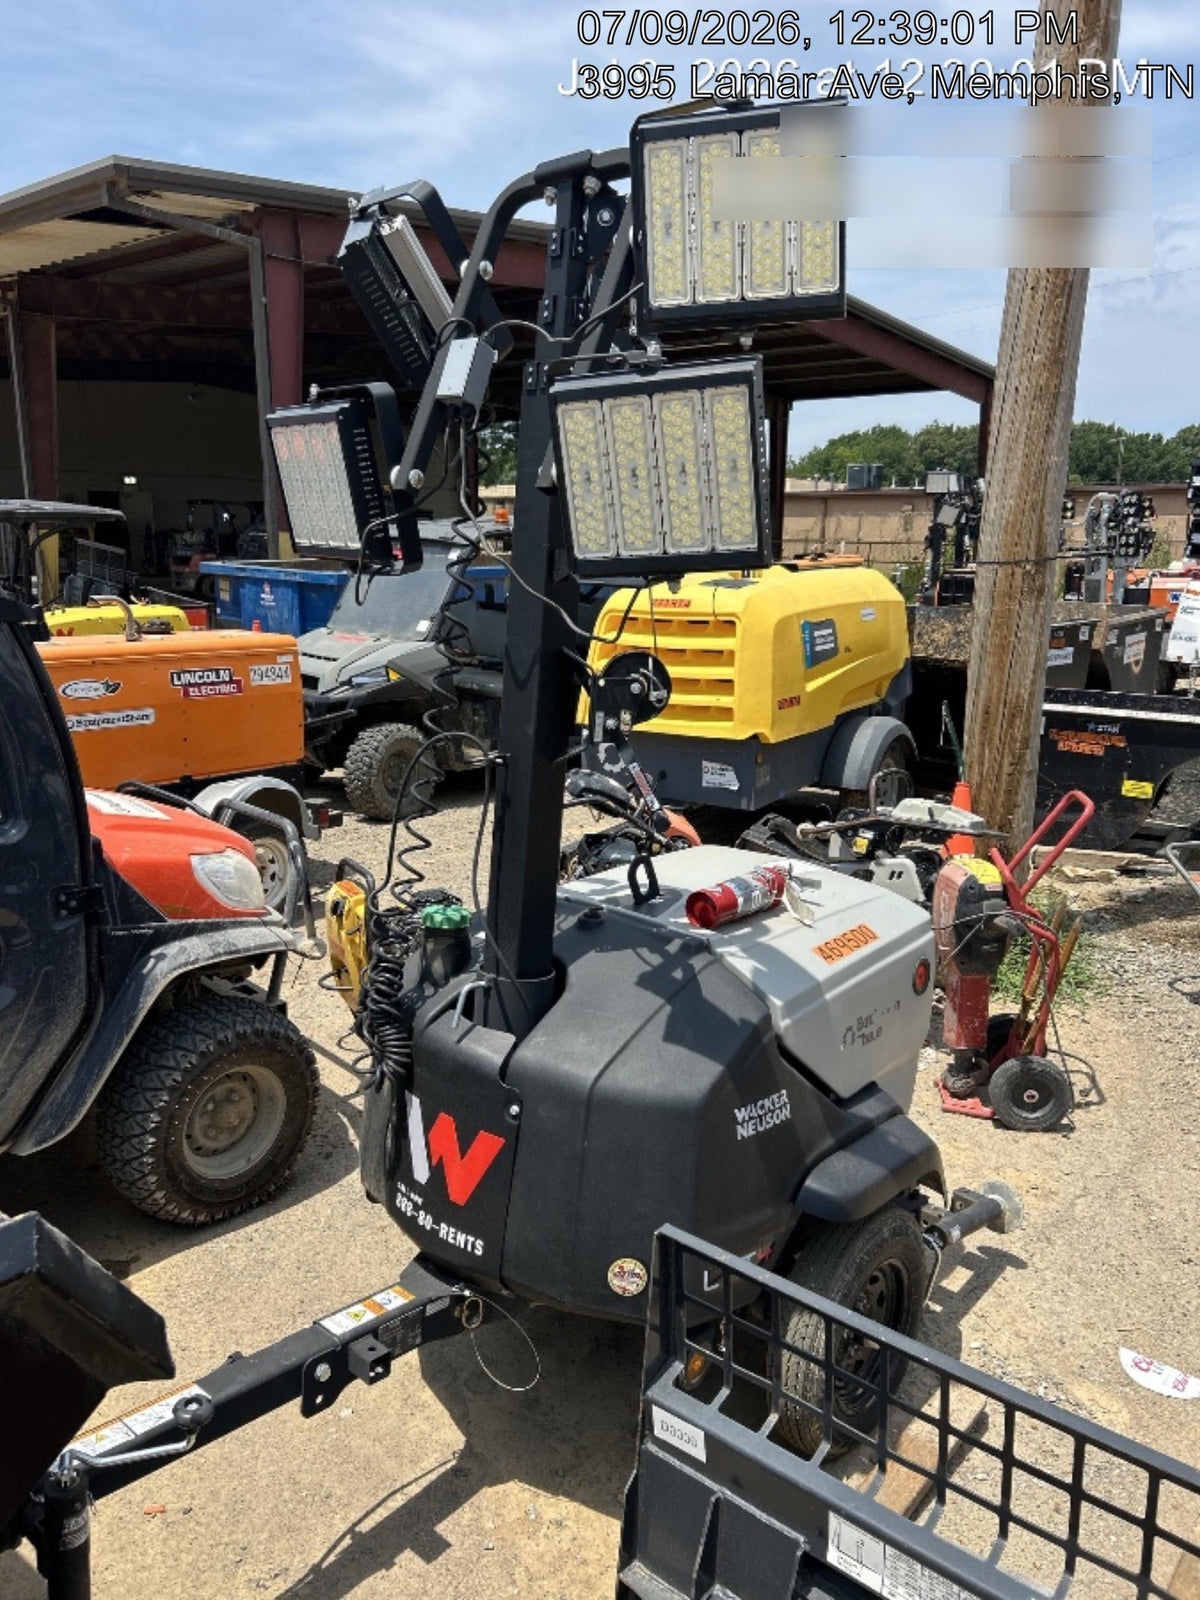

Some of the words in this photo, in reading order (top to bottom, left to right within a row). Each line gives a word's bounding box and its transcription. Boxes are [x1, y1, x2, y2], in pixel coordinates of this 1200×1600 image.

[172, 669, 231, 686] LINCOLN
[818, 925, 878, 961] 469500
[734, 1089, 790, 1124] WACKER
[736, 1103, 791, 1140] NEUSON
[396, 1192, 484, 1256] 888-80-RENTS
